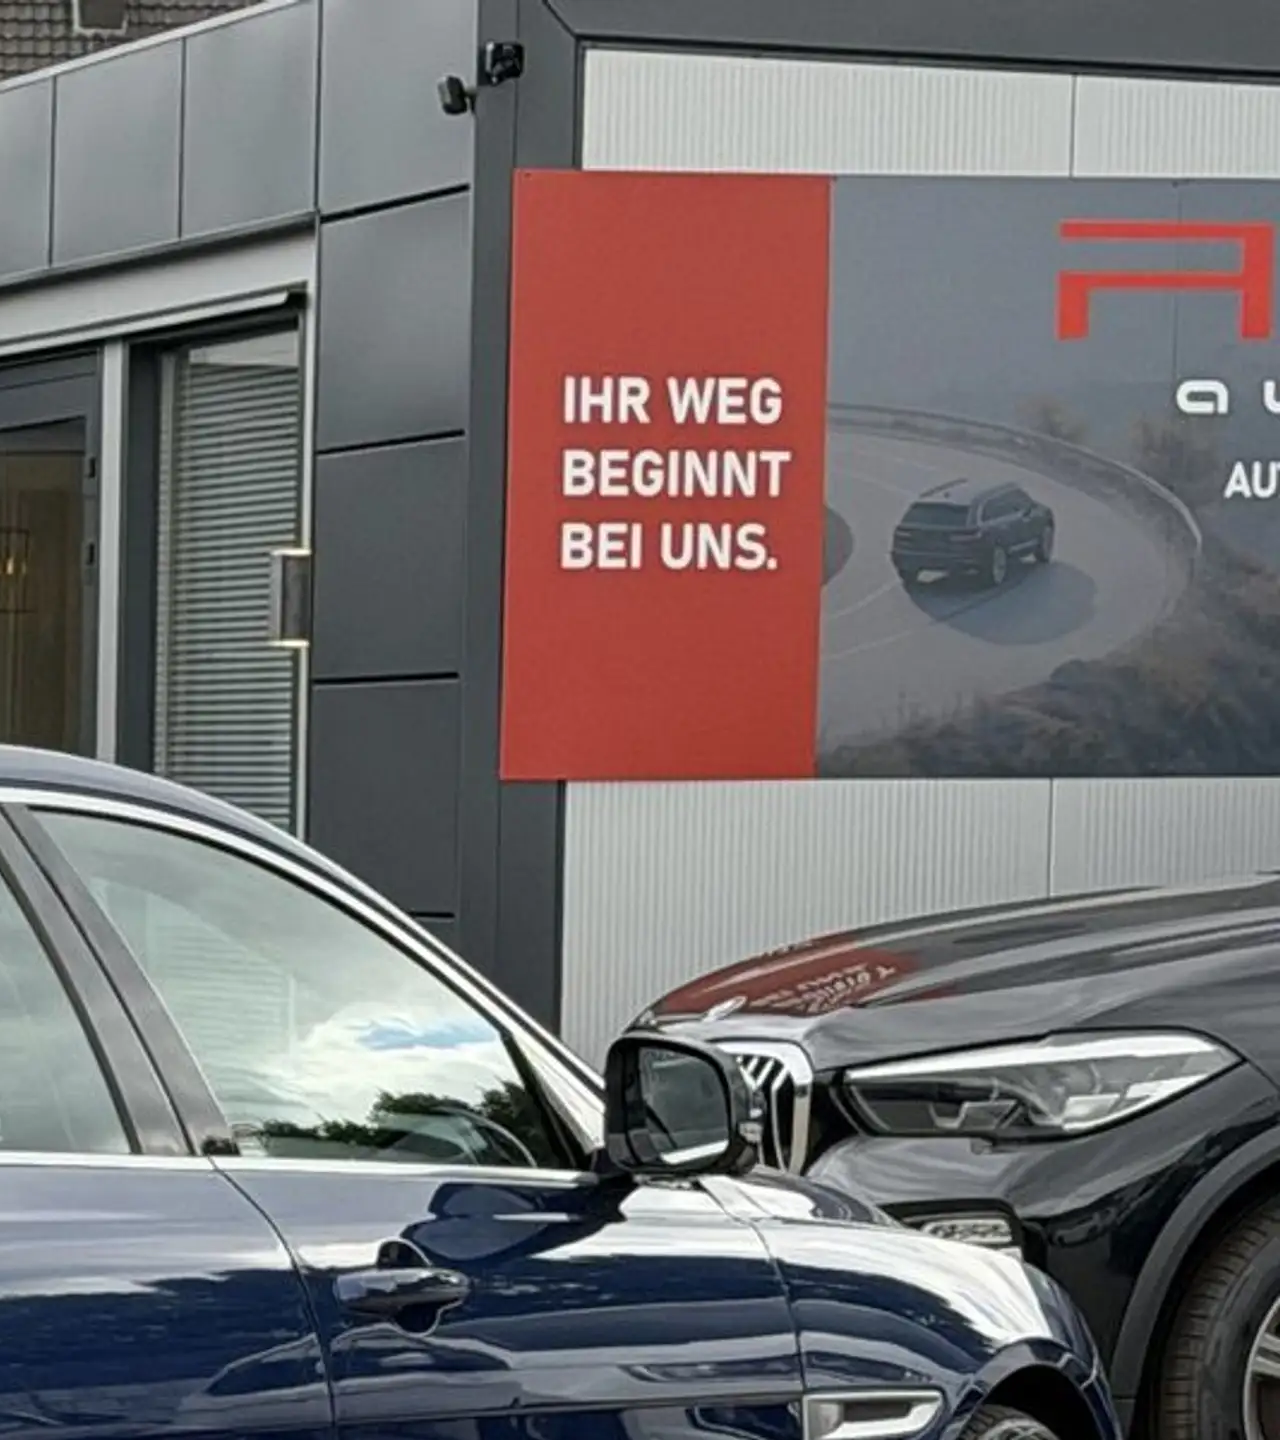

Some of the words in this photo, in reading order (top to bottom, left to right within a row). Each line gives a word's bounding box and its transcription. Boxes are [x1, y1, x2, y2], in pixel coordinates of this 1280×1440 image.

[562, 375, 651, 423] IHR
[667, 378, 783, 424] WEG
[562, 450, 791, 498] BEGINNT
[560, 523, 643, 570] BEI
[660, 523, 778, 571] UNS.
